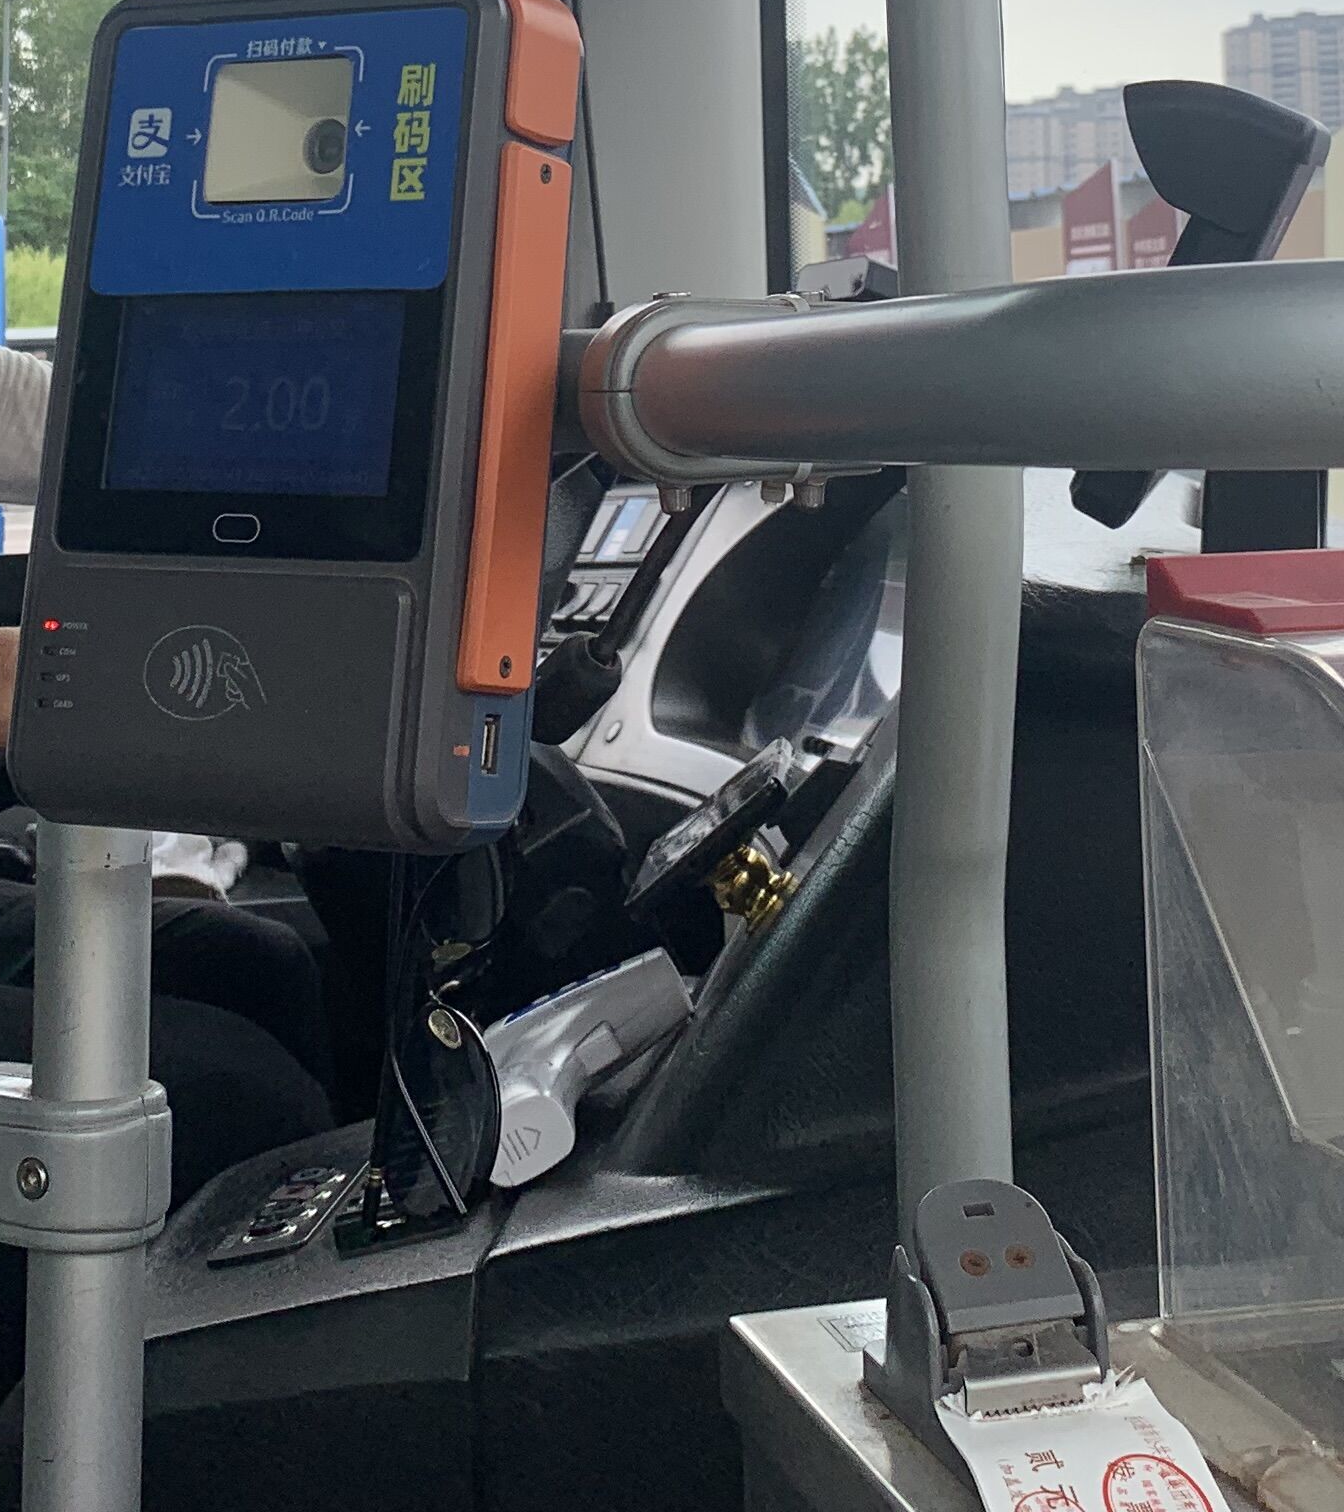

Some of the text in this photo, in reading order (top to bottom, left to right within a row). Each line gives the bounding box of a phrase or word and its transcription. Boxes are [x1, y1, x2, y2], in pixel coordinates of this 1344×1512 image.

[246, 39, 314, 57] 扫码付款
[389, 63, 436, 203] 刷码区
[117, 164, 172, 188] 支付宝
[221, 207, 253, 225] Scan
[1024, 1449, 1083, 1510] 贰元
